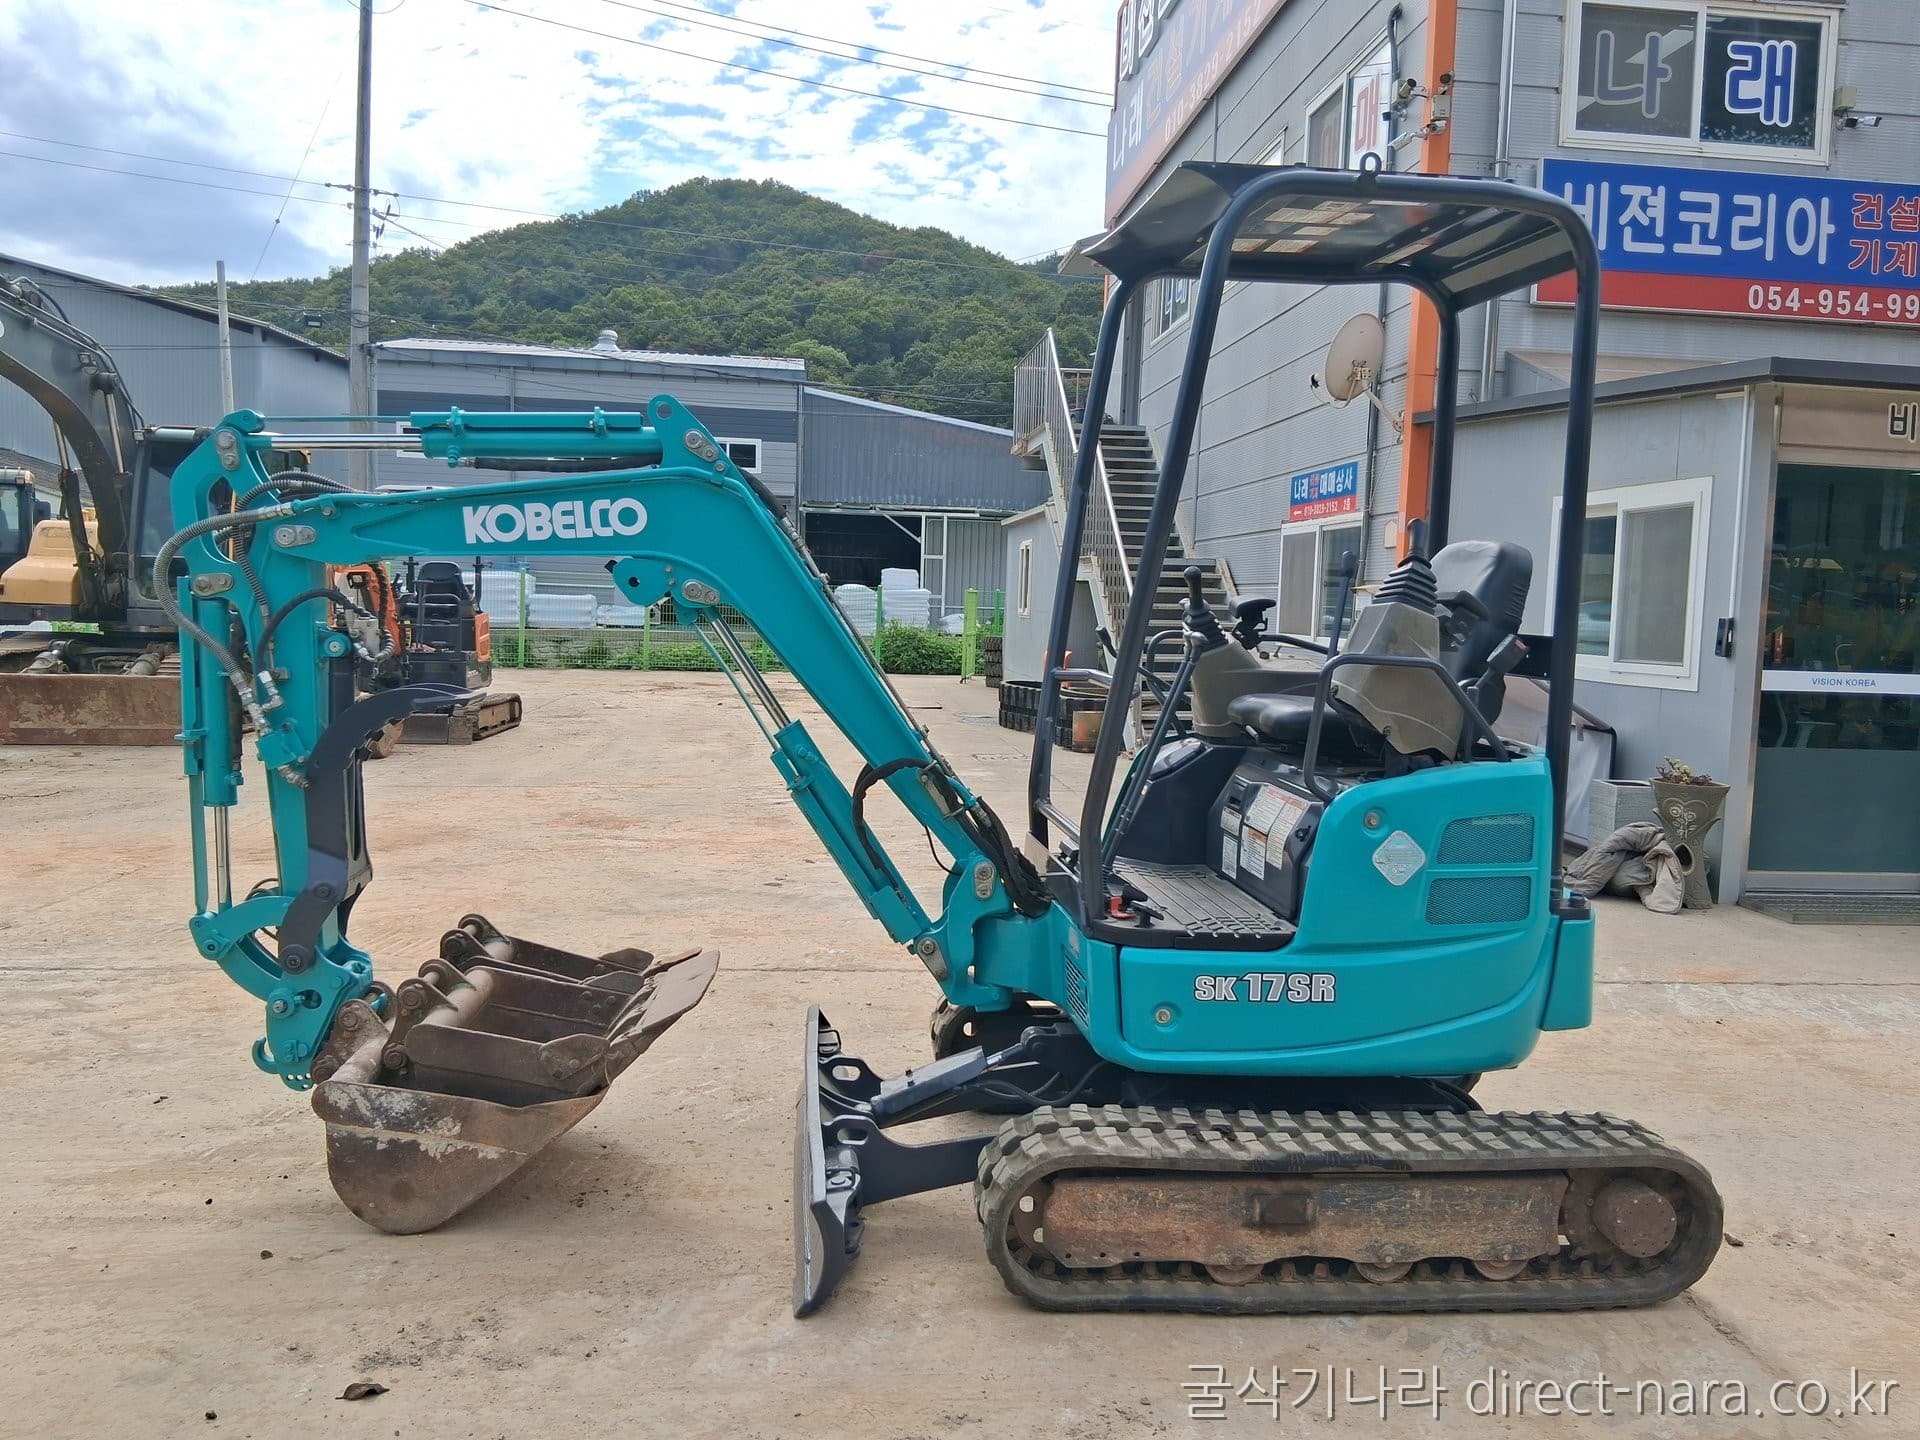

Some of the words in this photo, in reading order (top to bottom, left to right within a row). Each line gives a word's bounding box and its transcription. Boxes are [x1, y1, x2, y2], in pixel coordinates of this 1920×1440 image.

[1852, 193, 1920, 232] 건설
[1848, 239, 1918, 278] 기계
[462, 497, 648, 544] KOBELCO
[1812, 677, 1843, 687] VISION
[1845, 679, 1877, 688] KOREA
